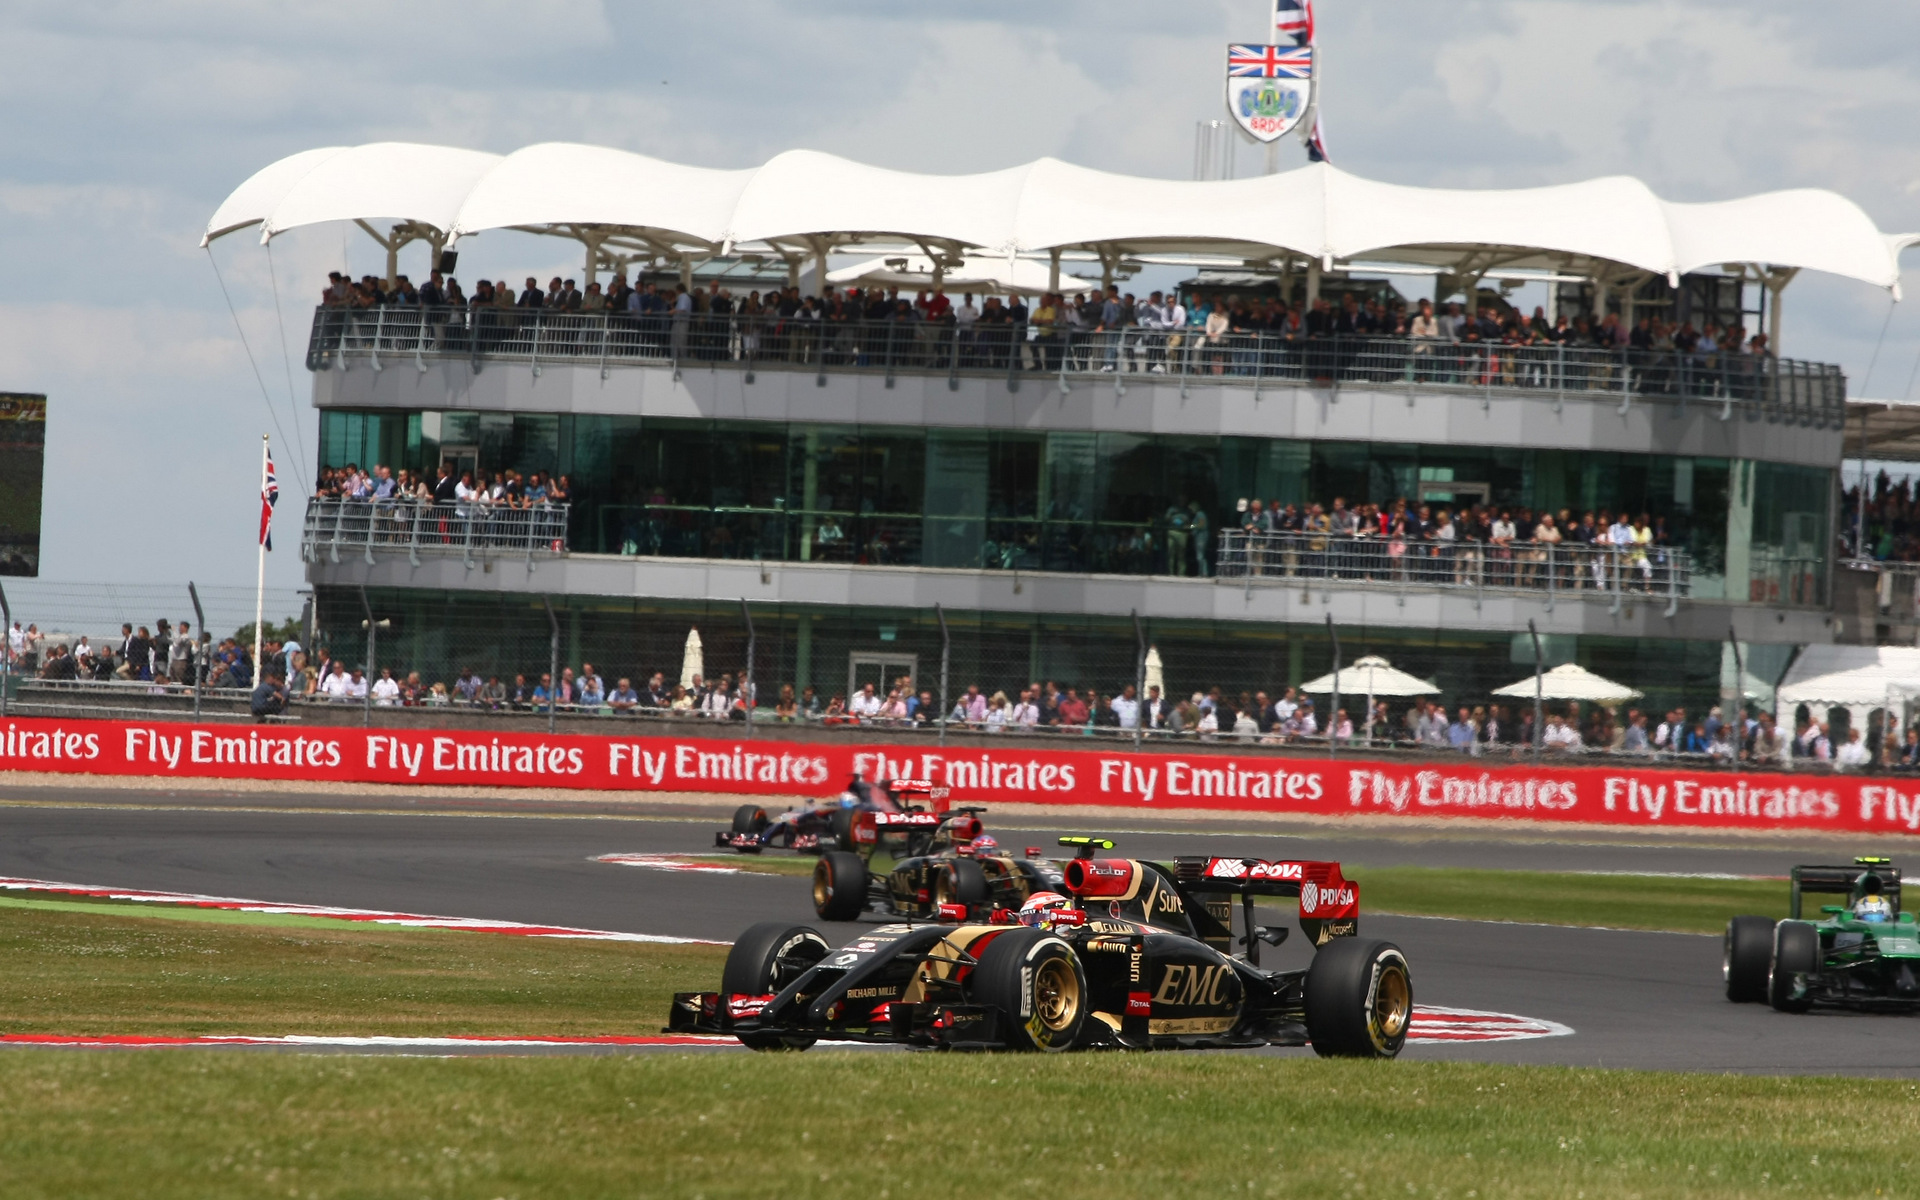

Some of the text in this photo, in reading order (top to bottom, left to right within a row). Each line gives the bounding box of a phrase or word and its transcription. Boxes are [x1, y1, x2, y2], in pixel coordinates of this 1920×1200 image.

[0, 724, 99, 759] irates
[126, 728, 340, 769] Fly Emirates
[367, 736, 583, 776] Fly Emirates
[609, 743, 829, 784] Fly Emirates
[921, 754, 1076, 791] Emirates
[1100, 760, 1323, 801] Fly Emirates
[1349, 770, 1578, 811] Fly Emirates
[1604, 777, 1840, 819] Fly Emirates
[1861, 785, 1920, 829] Fly
[889, 813, 936, 823] PDVSA
[1089, 865, 1127, 876] Pastor
[1159, 890, 1184, 913] Sure
[1320, 888, 1354, 906] PDVSA
[1129, 953, 1142, 982] burn
[847, 986, 897, 999] RICHARD MILLE
